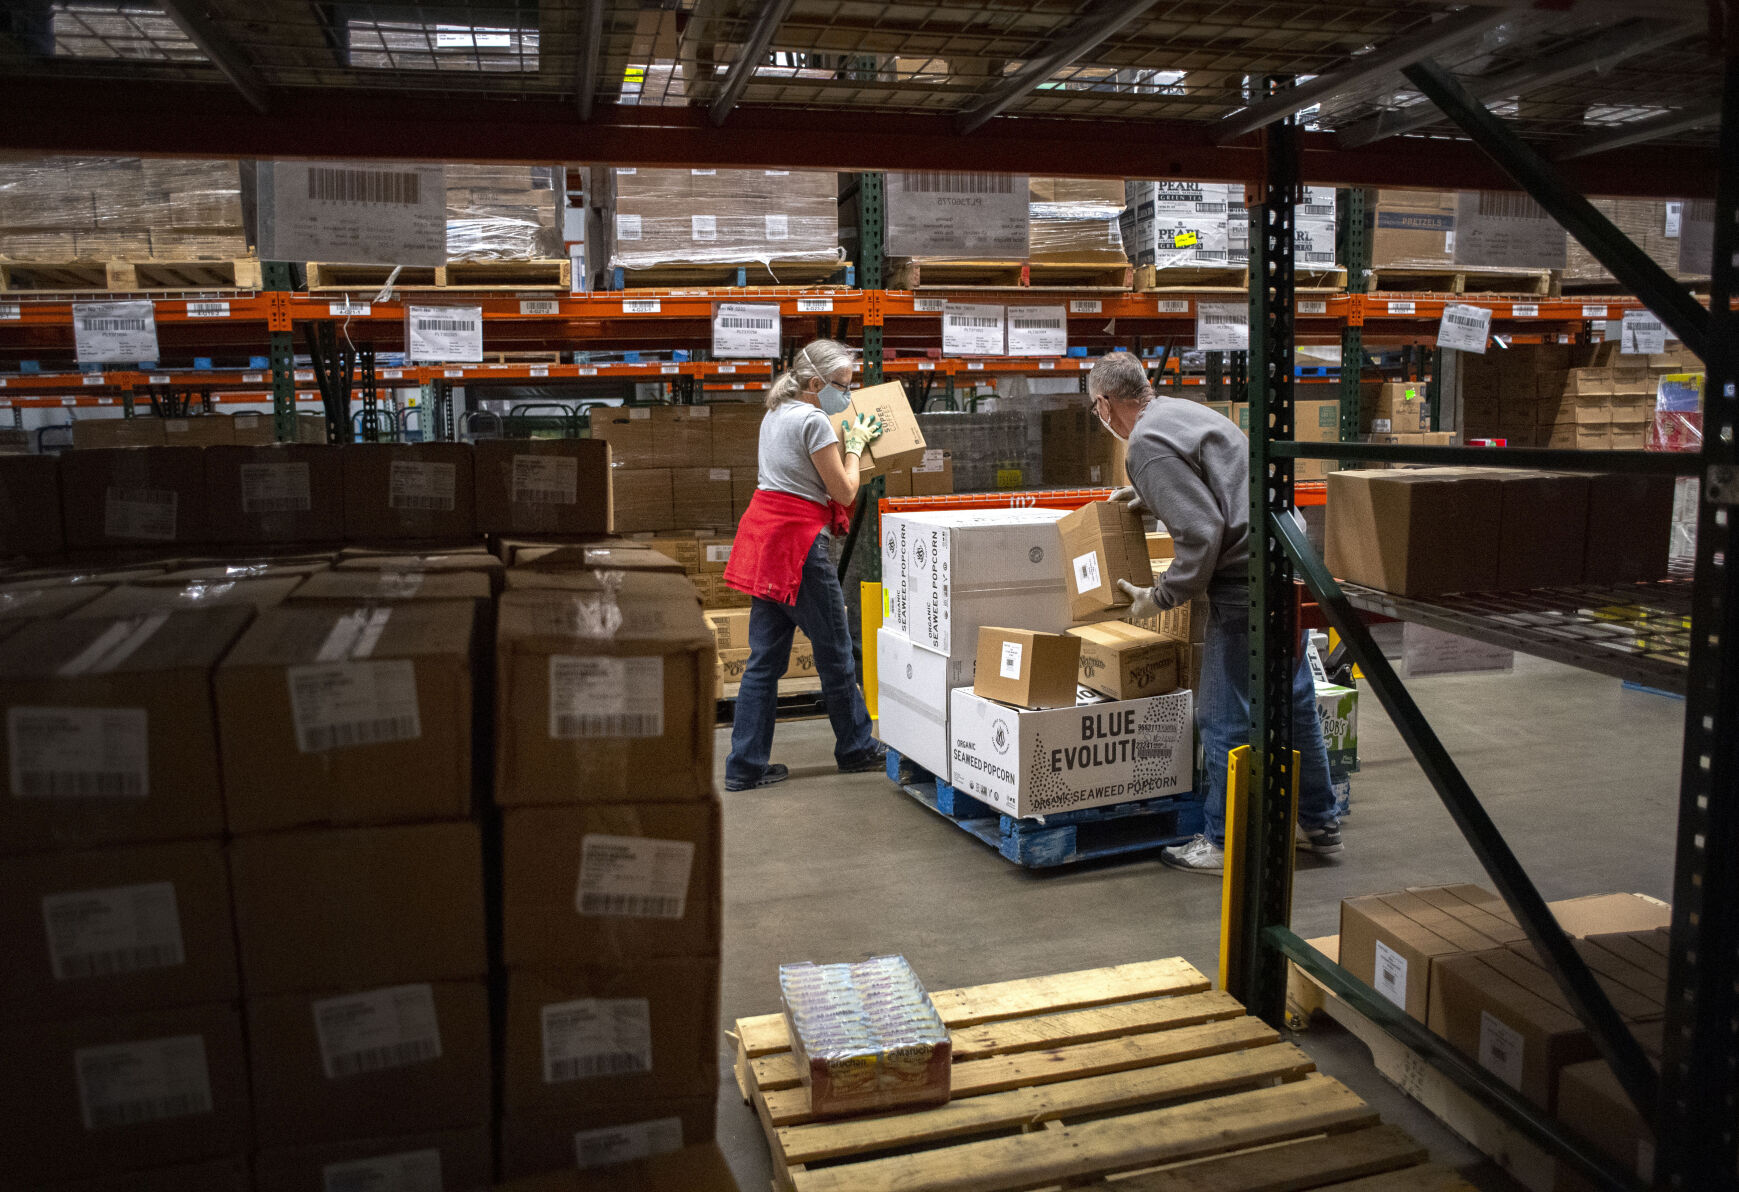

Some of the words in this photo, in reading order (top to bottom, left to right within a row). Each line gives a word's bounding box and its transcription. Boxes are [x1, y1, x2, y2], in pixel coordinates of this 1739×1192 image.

[1159, 181, 1202, 192] PEARL
[876, 407, 891, 433] SUPER
[880, 404, 897, 432] COFFEE
[1081, 710, 1135, 740] BLUE
[1324, 719, 1346, 736] ROB'S
[957, 739, 976, 751] ORGANIC
[1051, 739, 1136, 772] EVOLUTI
[953, 748, 982, 771] SEAWEED
[983, 760, 1015, 785] POPCORN
[1033, 792, 1074, 809] ORGANIC
[1074, 784, 1125, 801] SEAWEED
[1127, 775, 1178, 795] POPCORN
